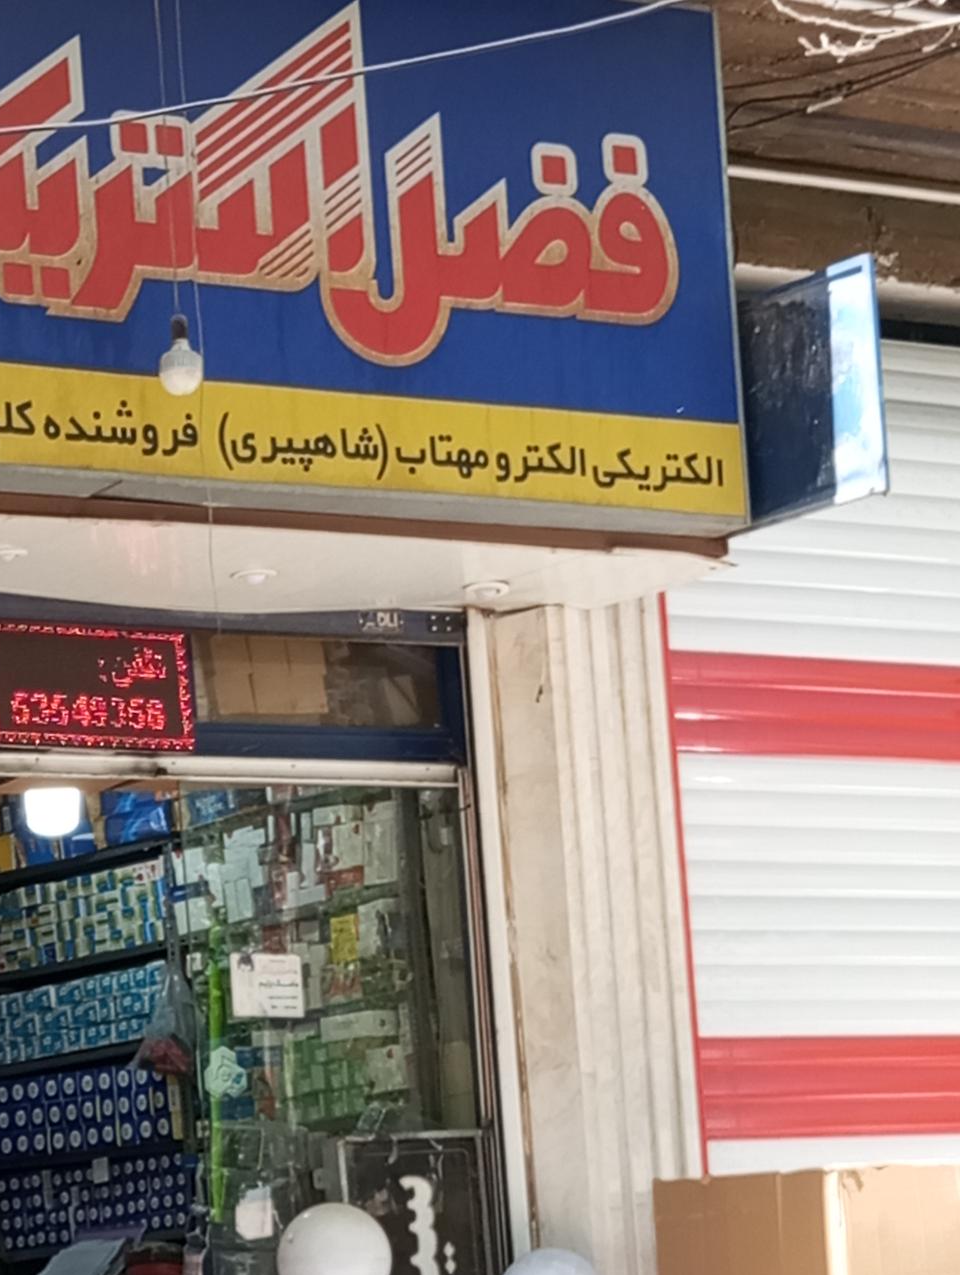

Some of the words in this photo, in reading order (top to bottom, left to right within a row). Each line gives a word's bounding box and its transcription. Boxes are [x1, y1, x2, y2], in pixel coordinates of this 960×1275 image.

[321, 113, 679, 367] فضل
[43, 400, 199, 456] فروشنده
[395, 434, 489, 479] مهتاب
[592, 450, 724, 491] الکتریکی
